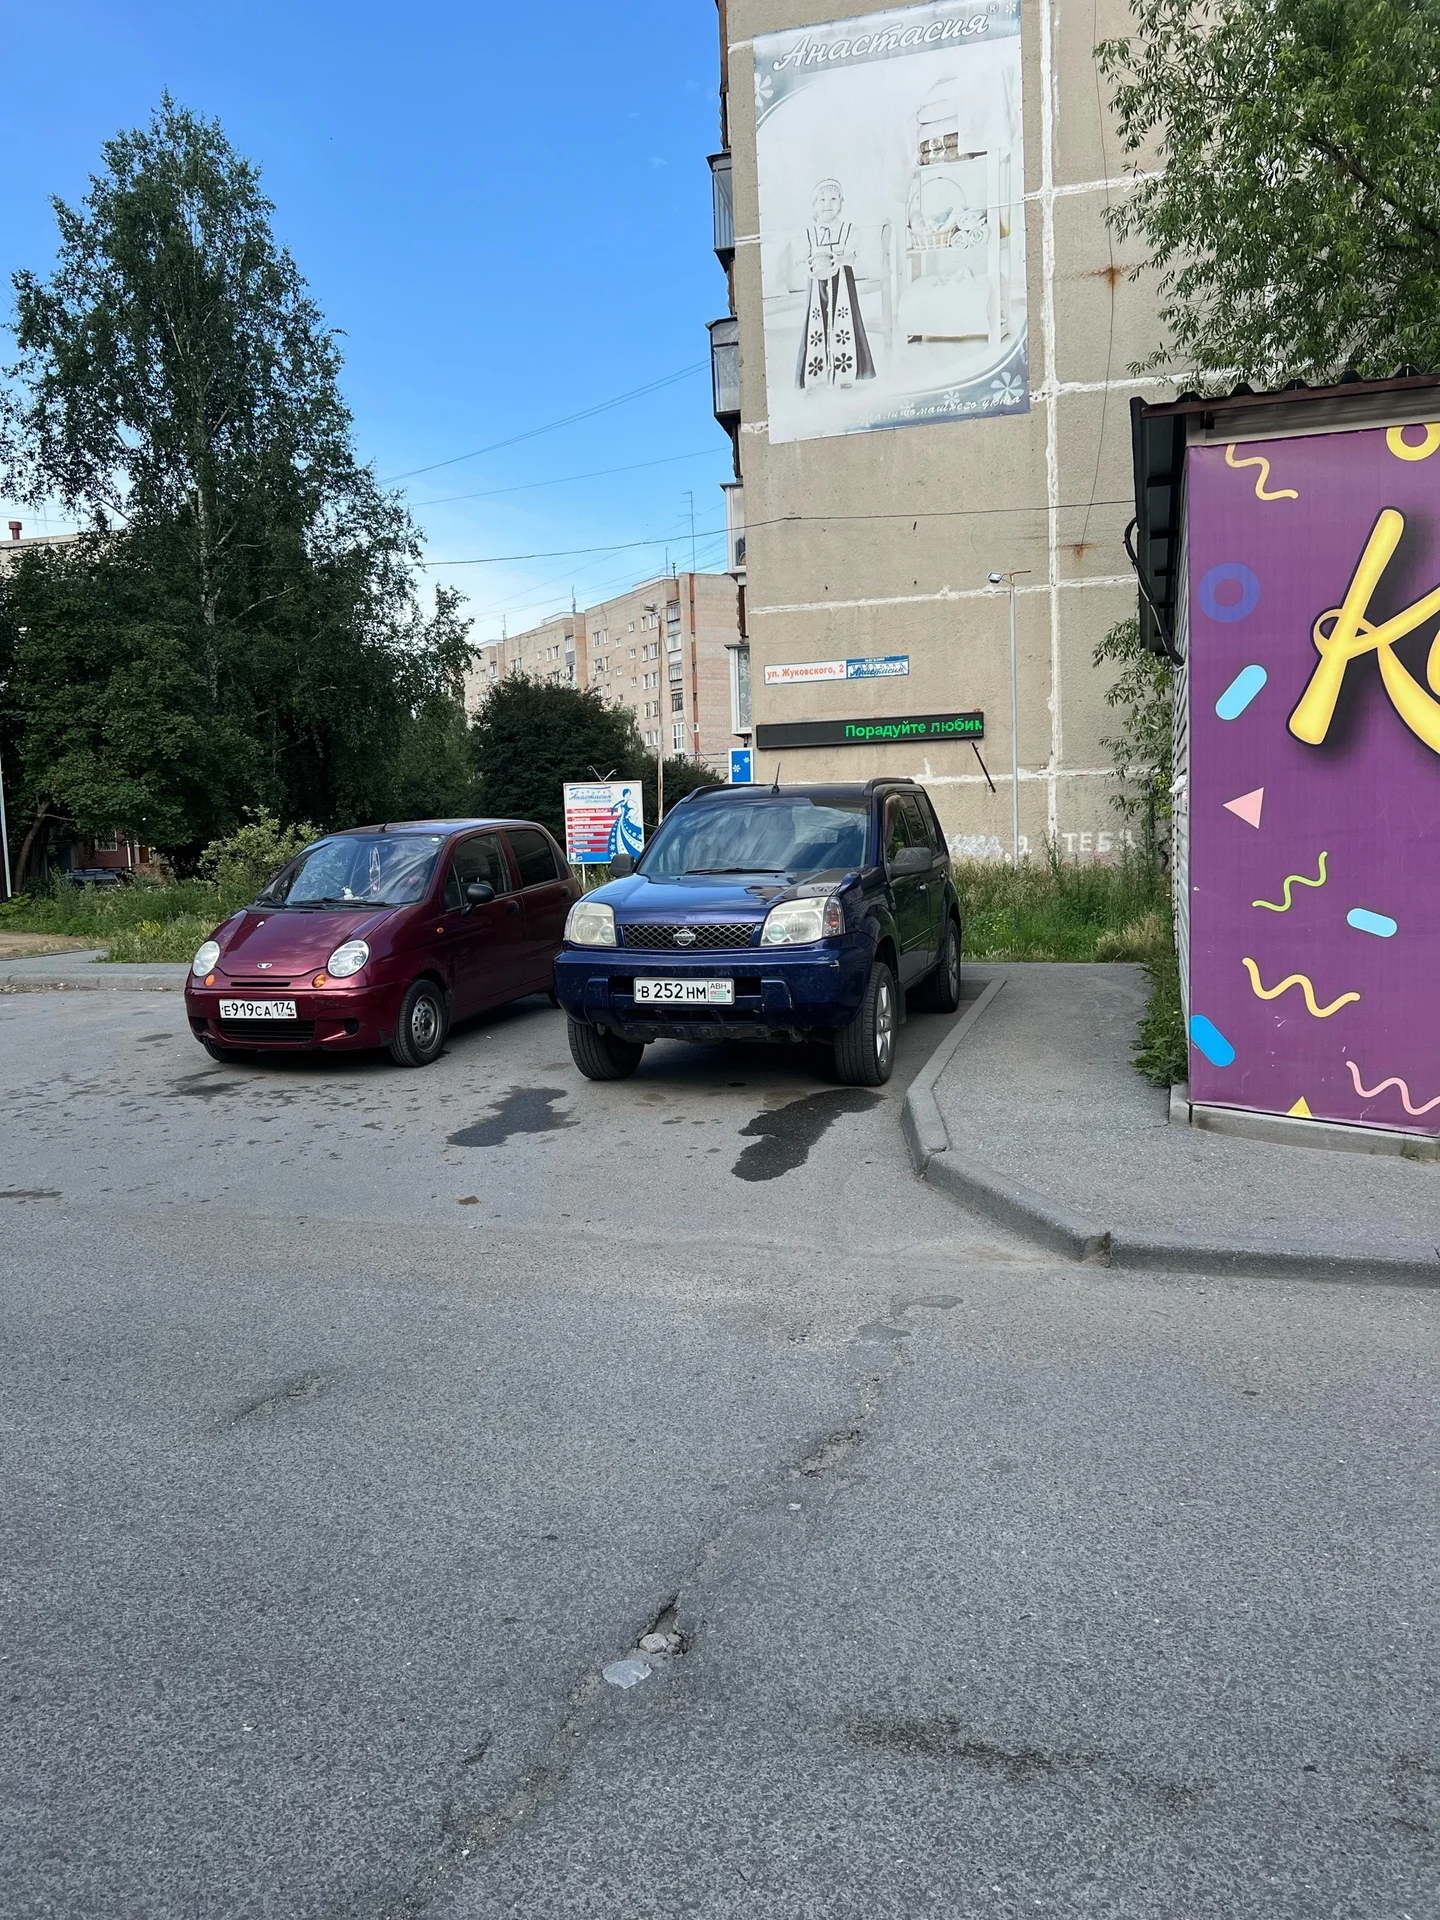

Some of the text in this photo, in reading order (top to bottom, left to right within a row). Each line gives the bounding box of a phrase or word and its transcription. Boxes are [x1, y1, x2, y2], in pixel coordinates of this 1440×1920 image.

[982, 395, 1022, 410] уюта
[767, 664, 845, 680] ул. Жуковского, 2
[845, 720, 926, 739] Порадуйте
[273, 1002, 293, 1013] 174
